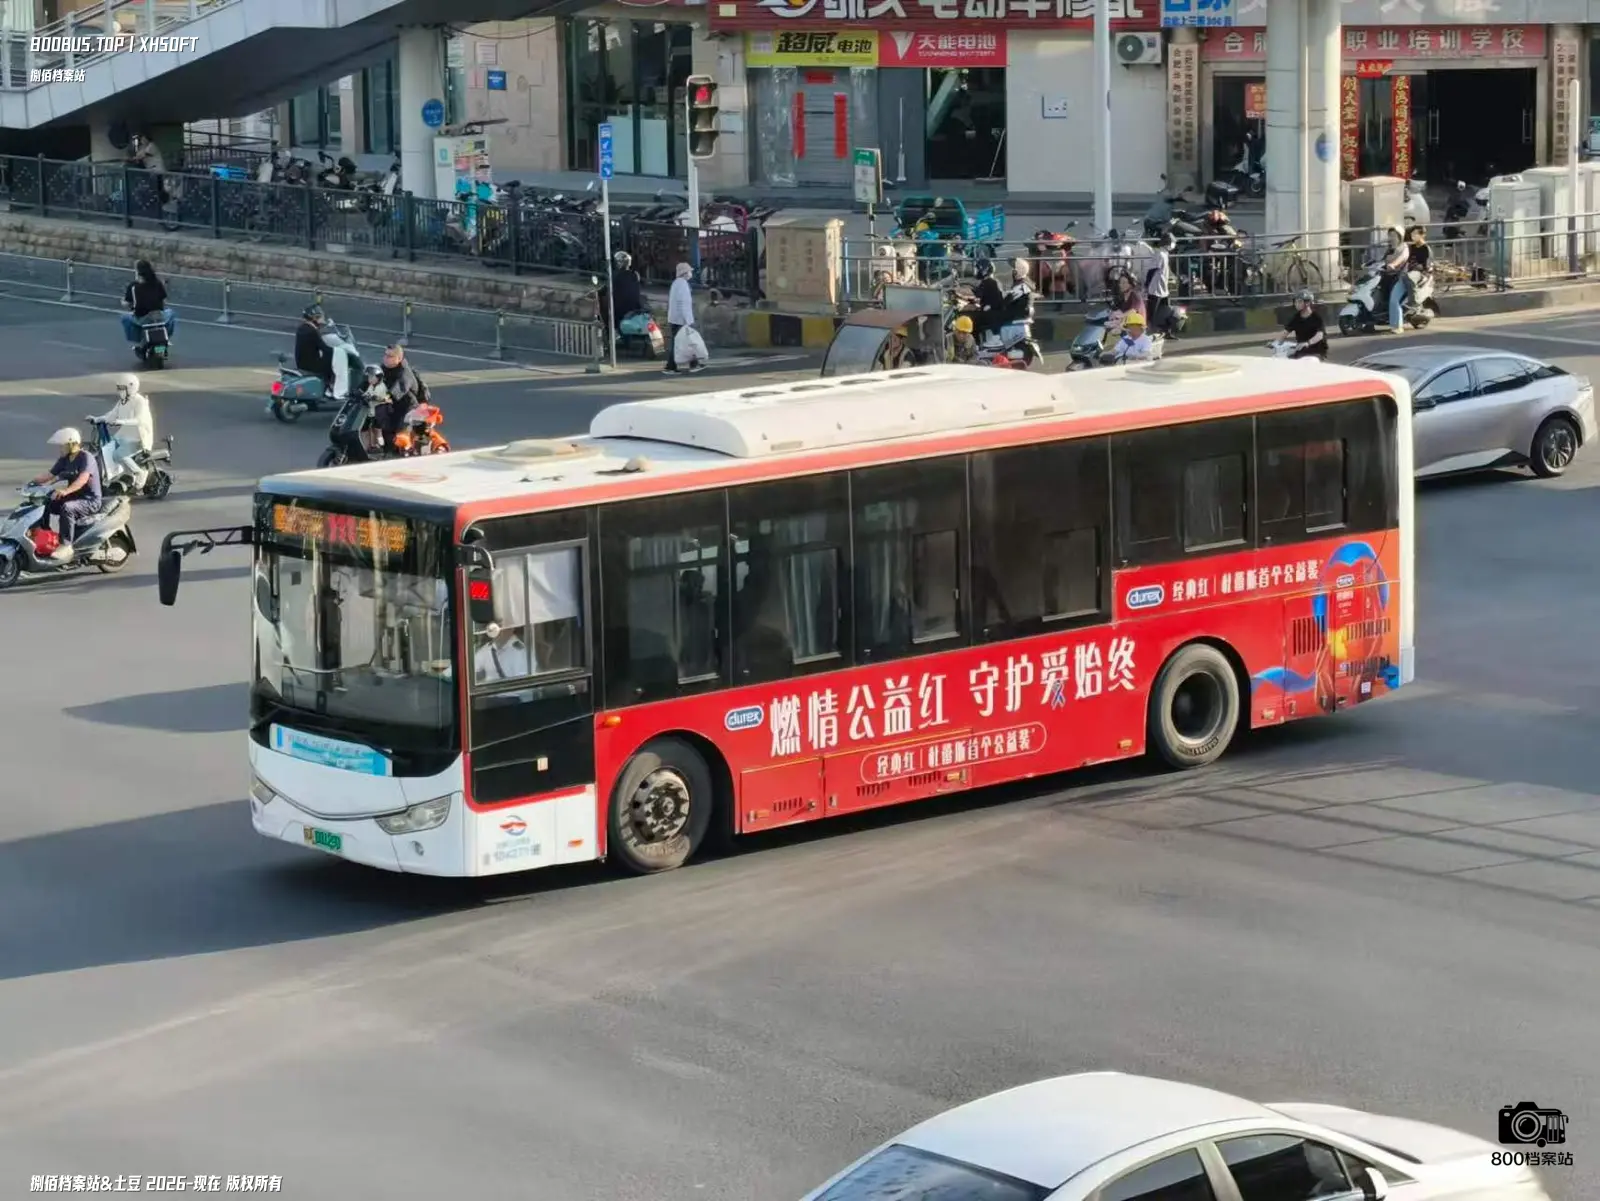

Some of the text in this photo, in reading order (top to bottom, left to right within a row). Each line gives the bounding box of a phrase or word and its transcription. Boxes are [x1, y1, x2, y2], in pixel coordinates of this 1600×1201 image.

[918, 34, 997, 50] 天能电池
[1345, 28, 1525, 51] 职业培训学校
[1128, 589, 1162, 606] durex
[1171, 577, 1209, 602] 经典红
[769, 636, 1136, 758] 燃情公益红 守护爱始终
[727, 709, 762, 727] durex
[876, 751, 916, 778] 经典红
